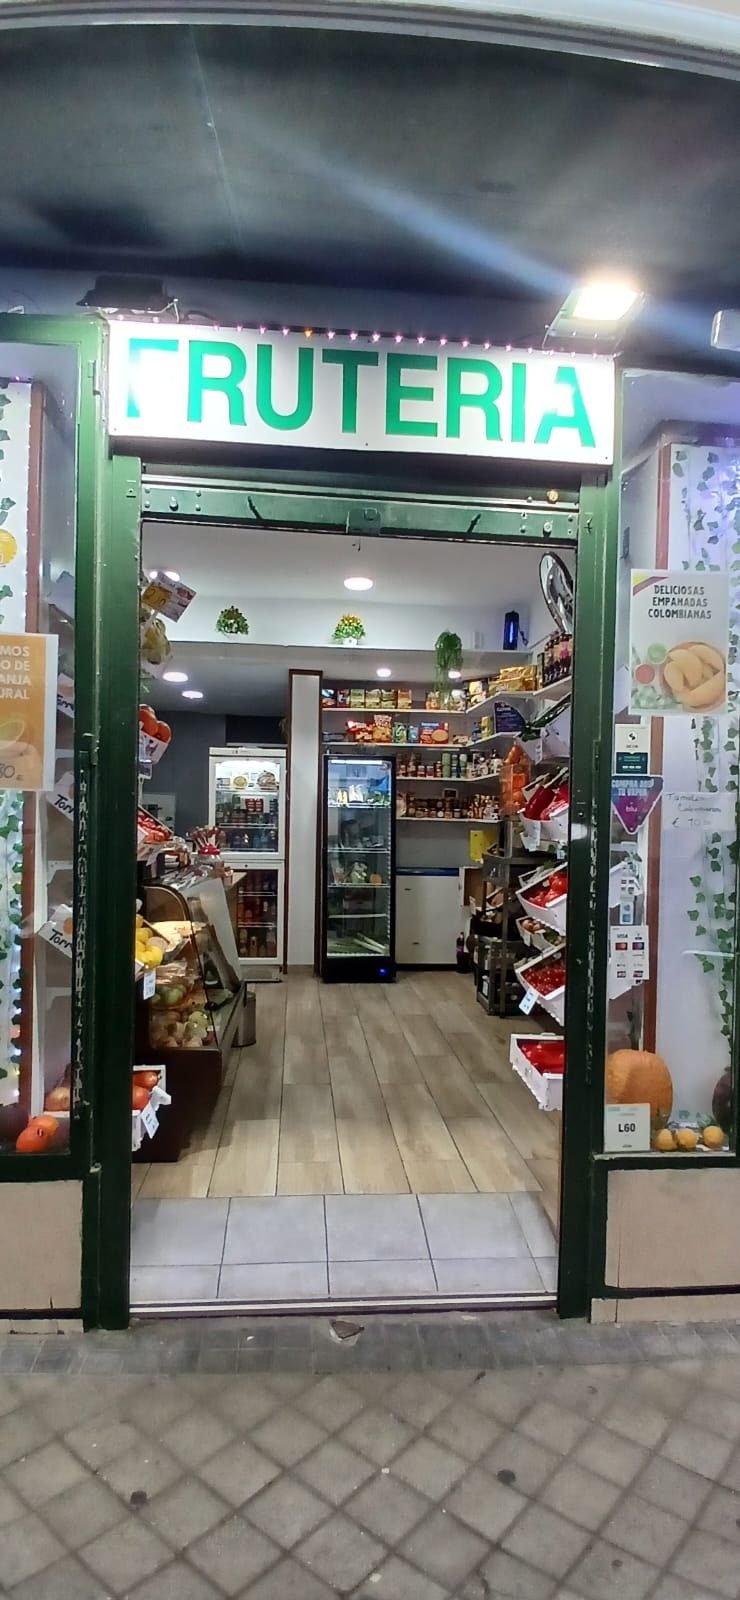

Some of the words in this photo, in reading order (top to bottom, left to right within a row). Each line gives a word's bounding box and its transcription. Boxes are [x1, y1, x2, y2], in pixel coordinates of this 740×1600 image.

[654, 585, 705, 595] DELICIOSAS
[652, 597, 708, 607] EMPANADAS
[648, 608, 712, 619] COLOMBIANAS
[14, 660, 31, 671] DE
[618, 1122, 636, 1133] L60
